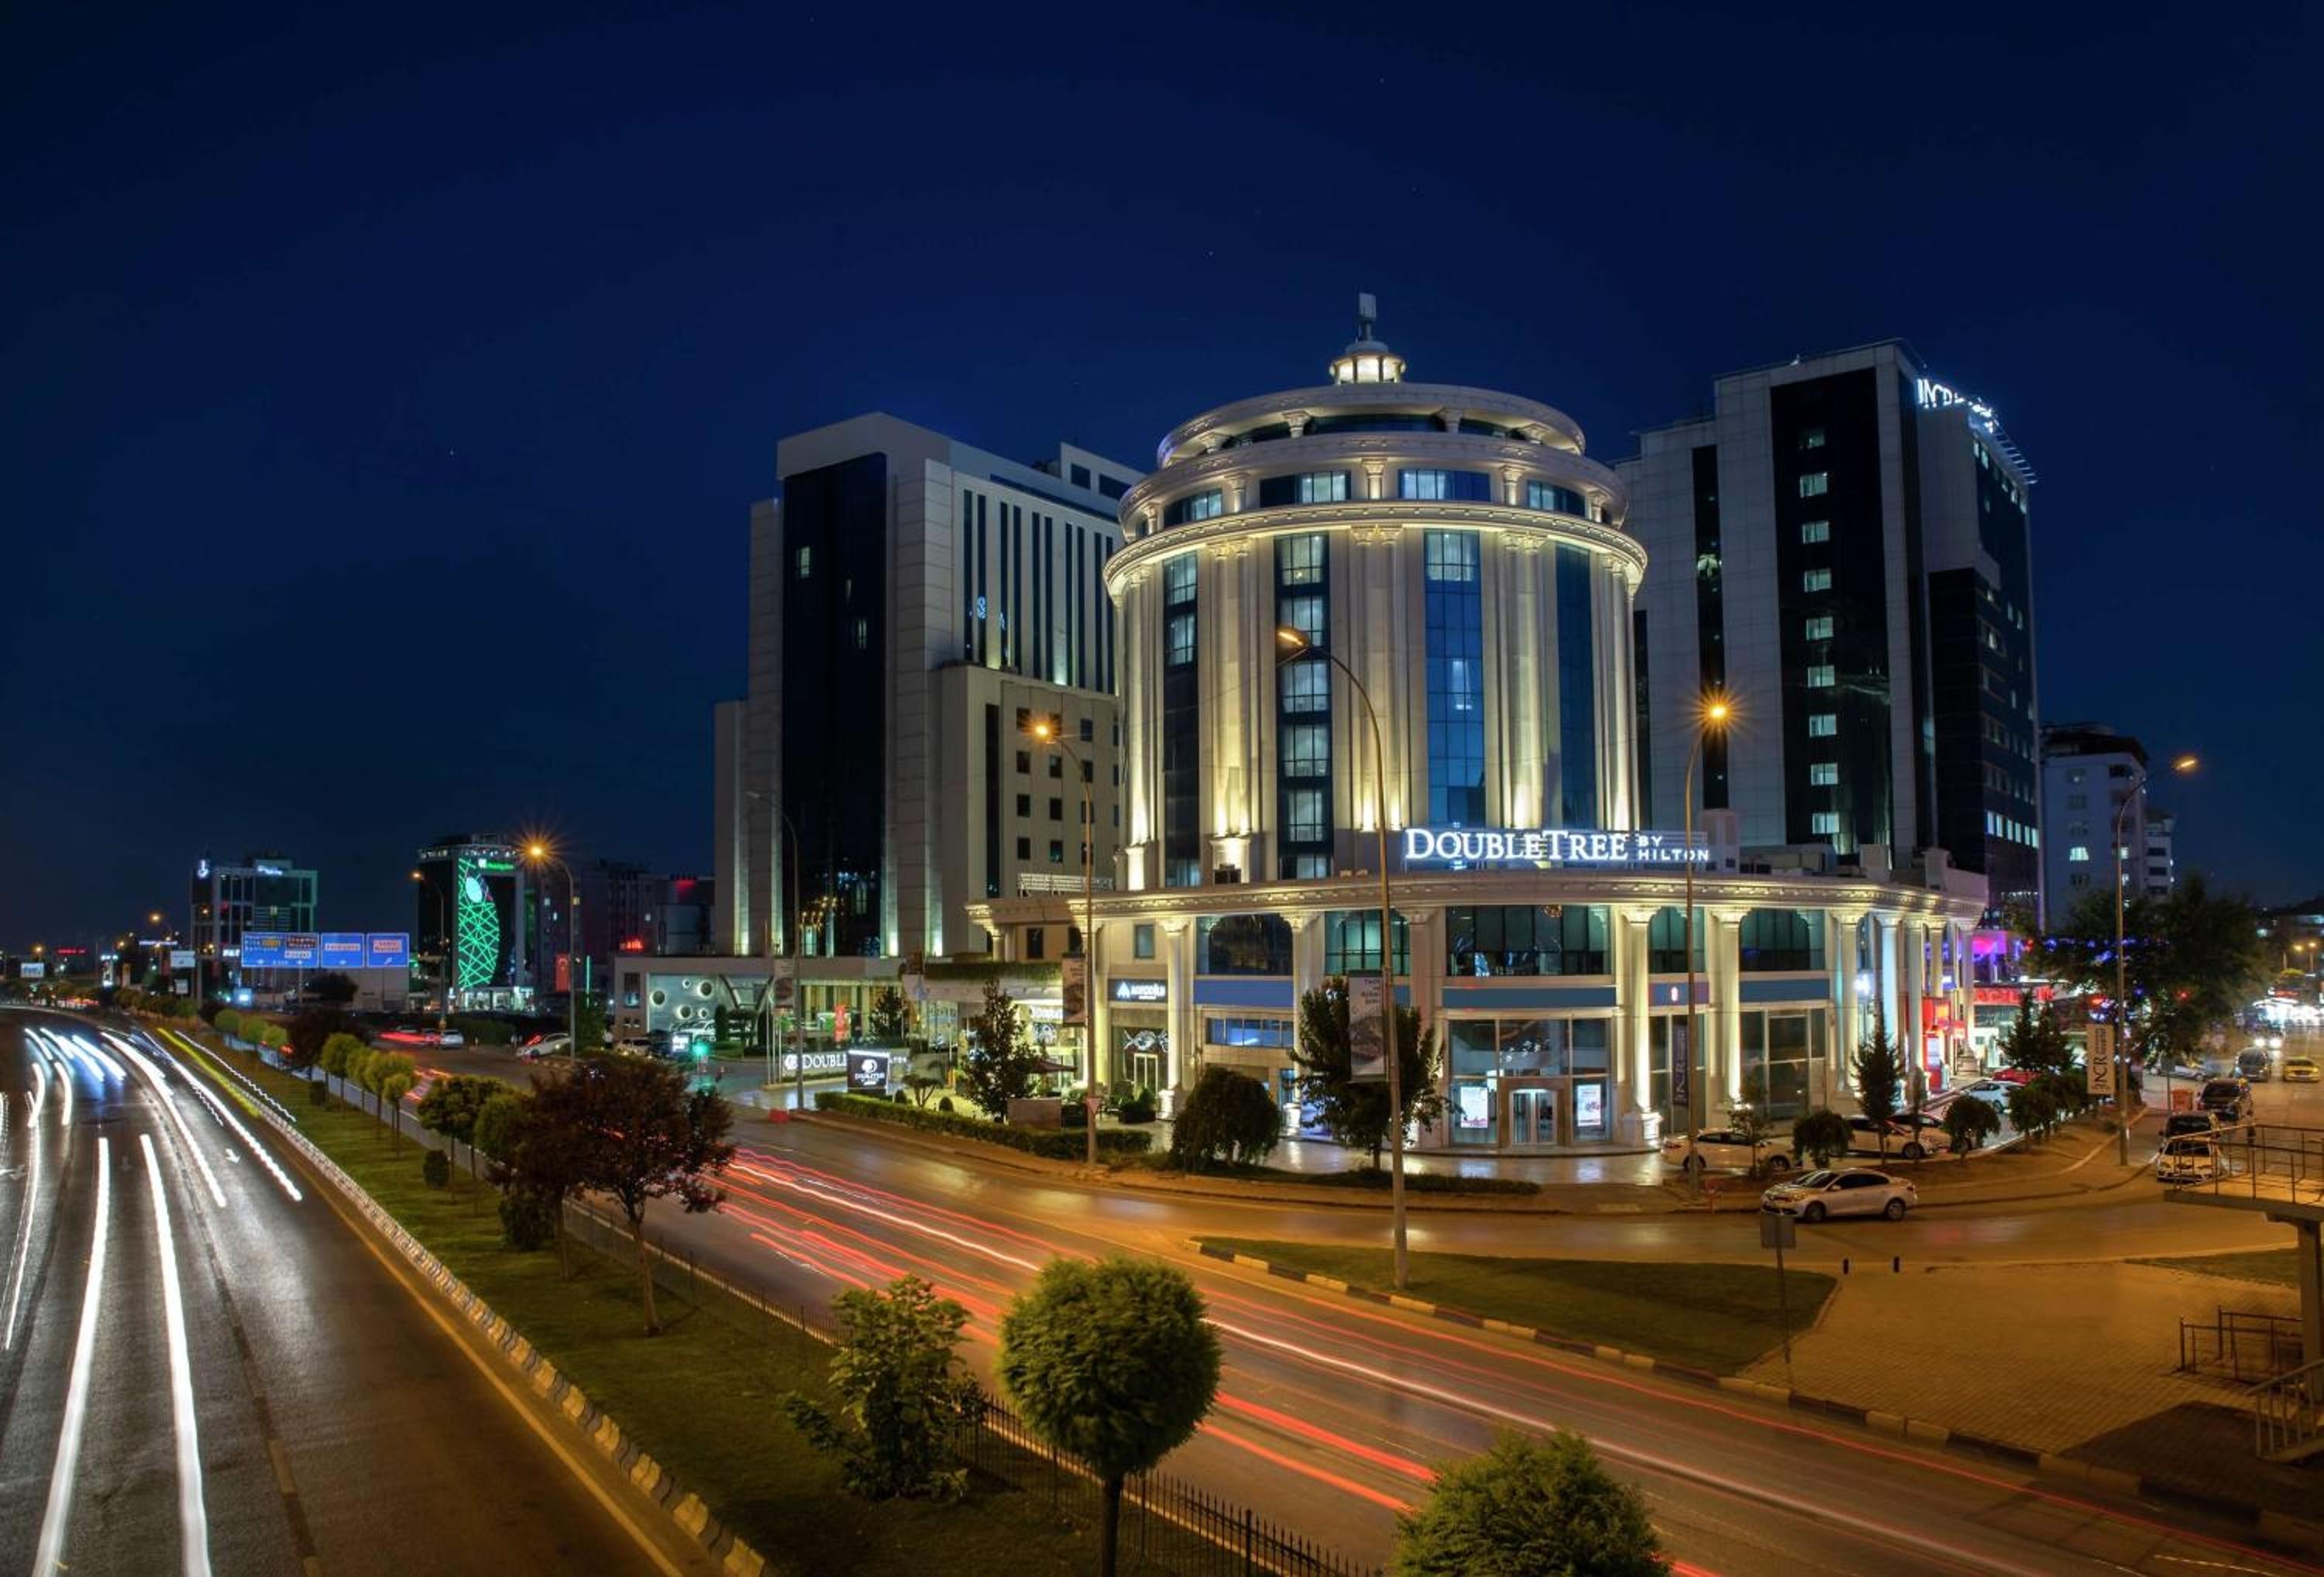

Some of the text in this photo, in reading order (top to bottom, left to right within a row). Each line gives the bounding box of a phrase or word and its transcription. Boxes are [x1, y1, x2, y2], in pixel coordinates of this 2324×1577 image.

[1405, 828, 1628, 861] DOUBLETREE
[1638, 835, 1663, 847] BY
[1638, 849, 1709, 862] HILTON
